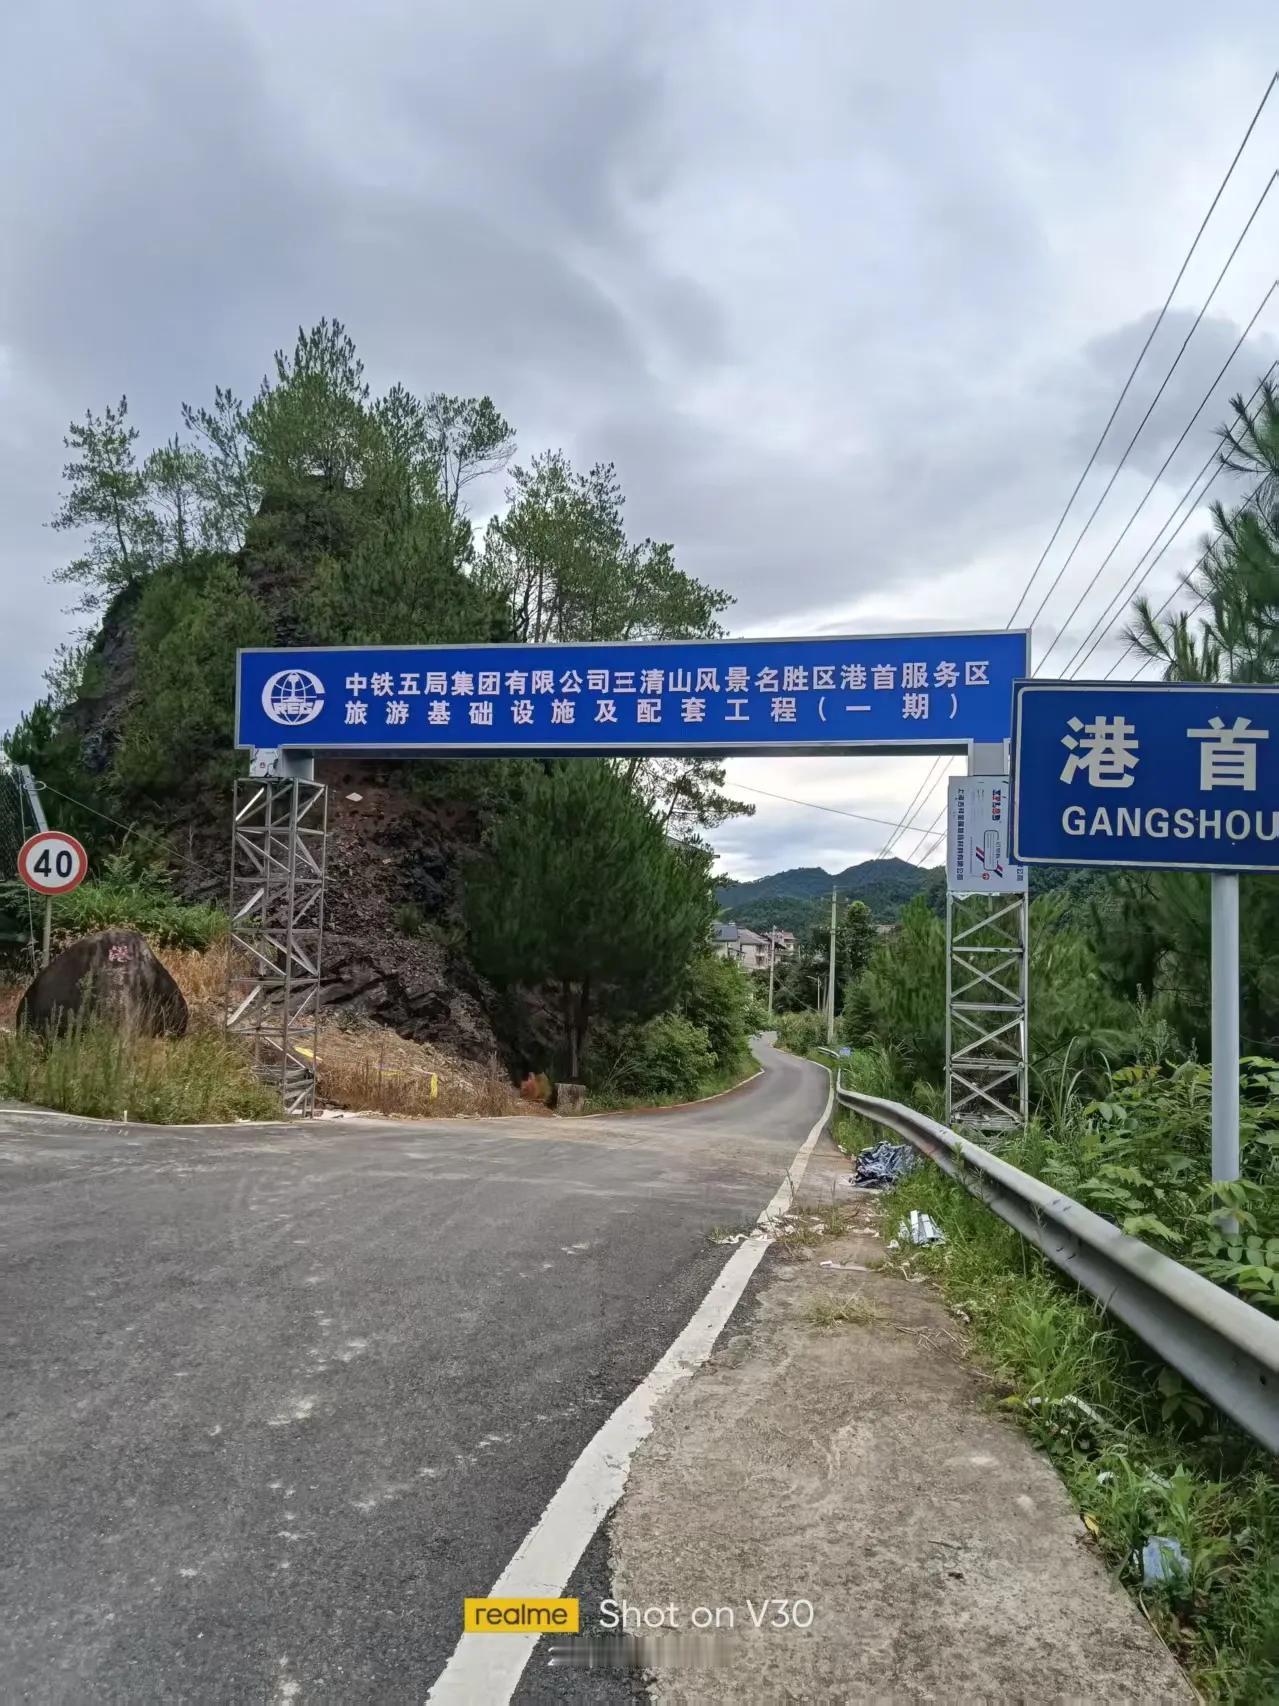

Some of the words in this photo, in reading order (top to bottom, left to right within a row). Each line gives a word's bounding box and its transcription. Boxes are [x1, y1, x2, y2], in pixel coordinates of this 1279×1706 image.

[345, 660, 990, 697] 中铁五局集团有限公司三清山风景名胜区港首服务区
[1059, 716, 1270, 791] 港首
[1062, 805, 1279, 841] GANGSHOU
[34, 848, 73, 878] 40
